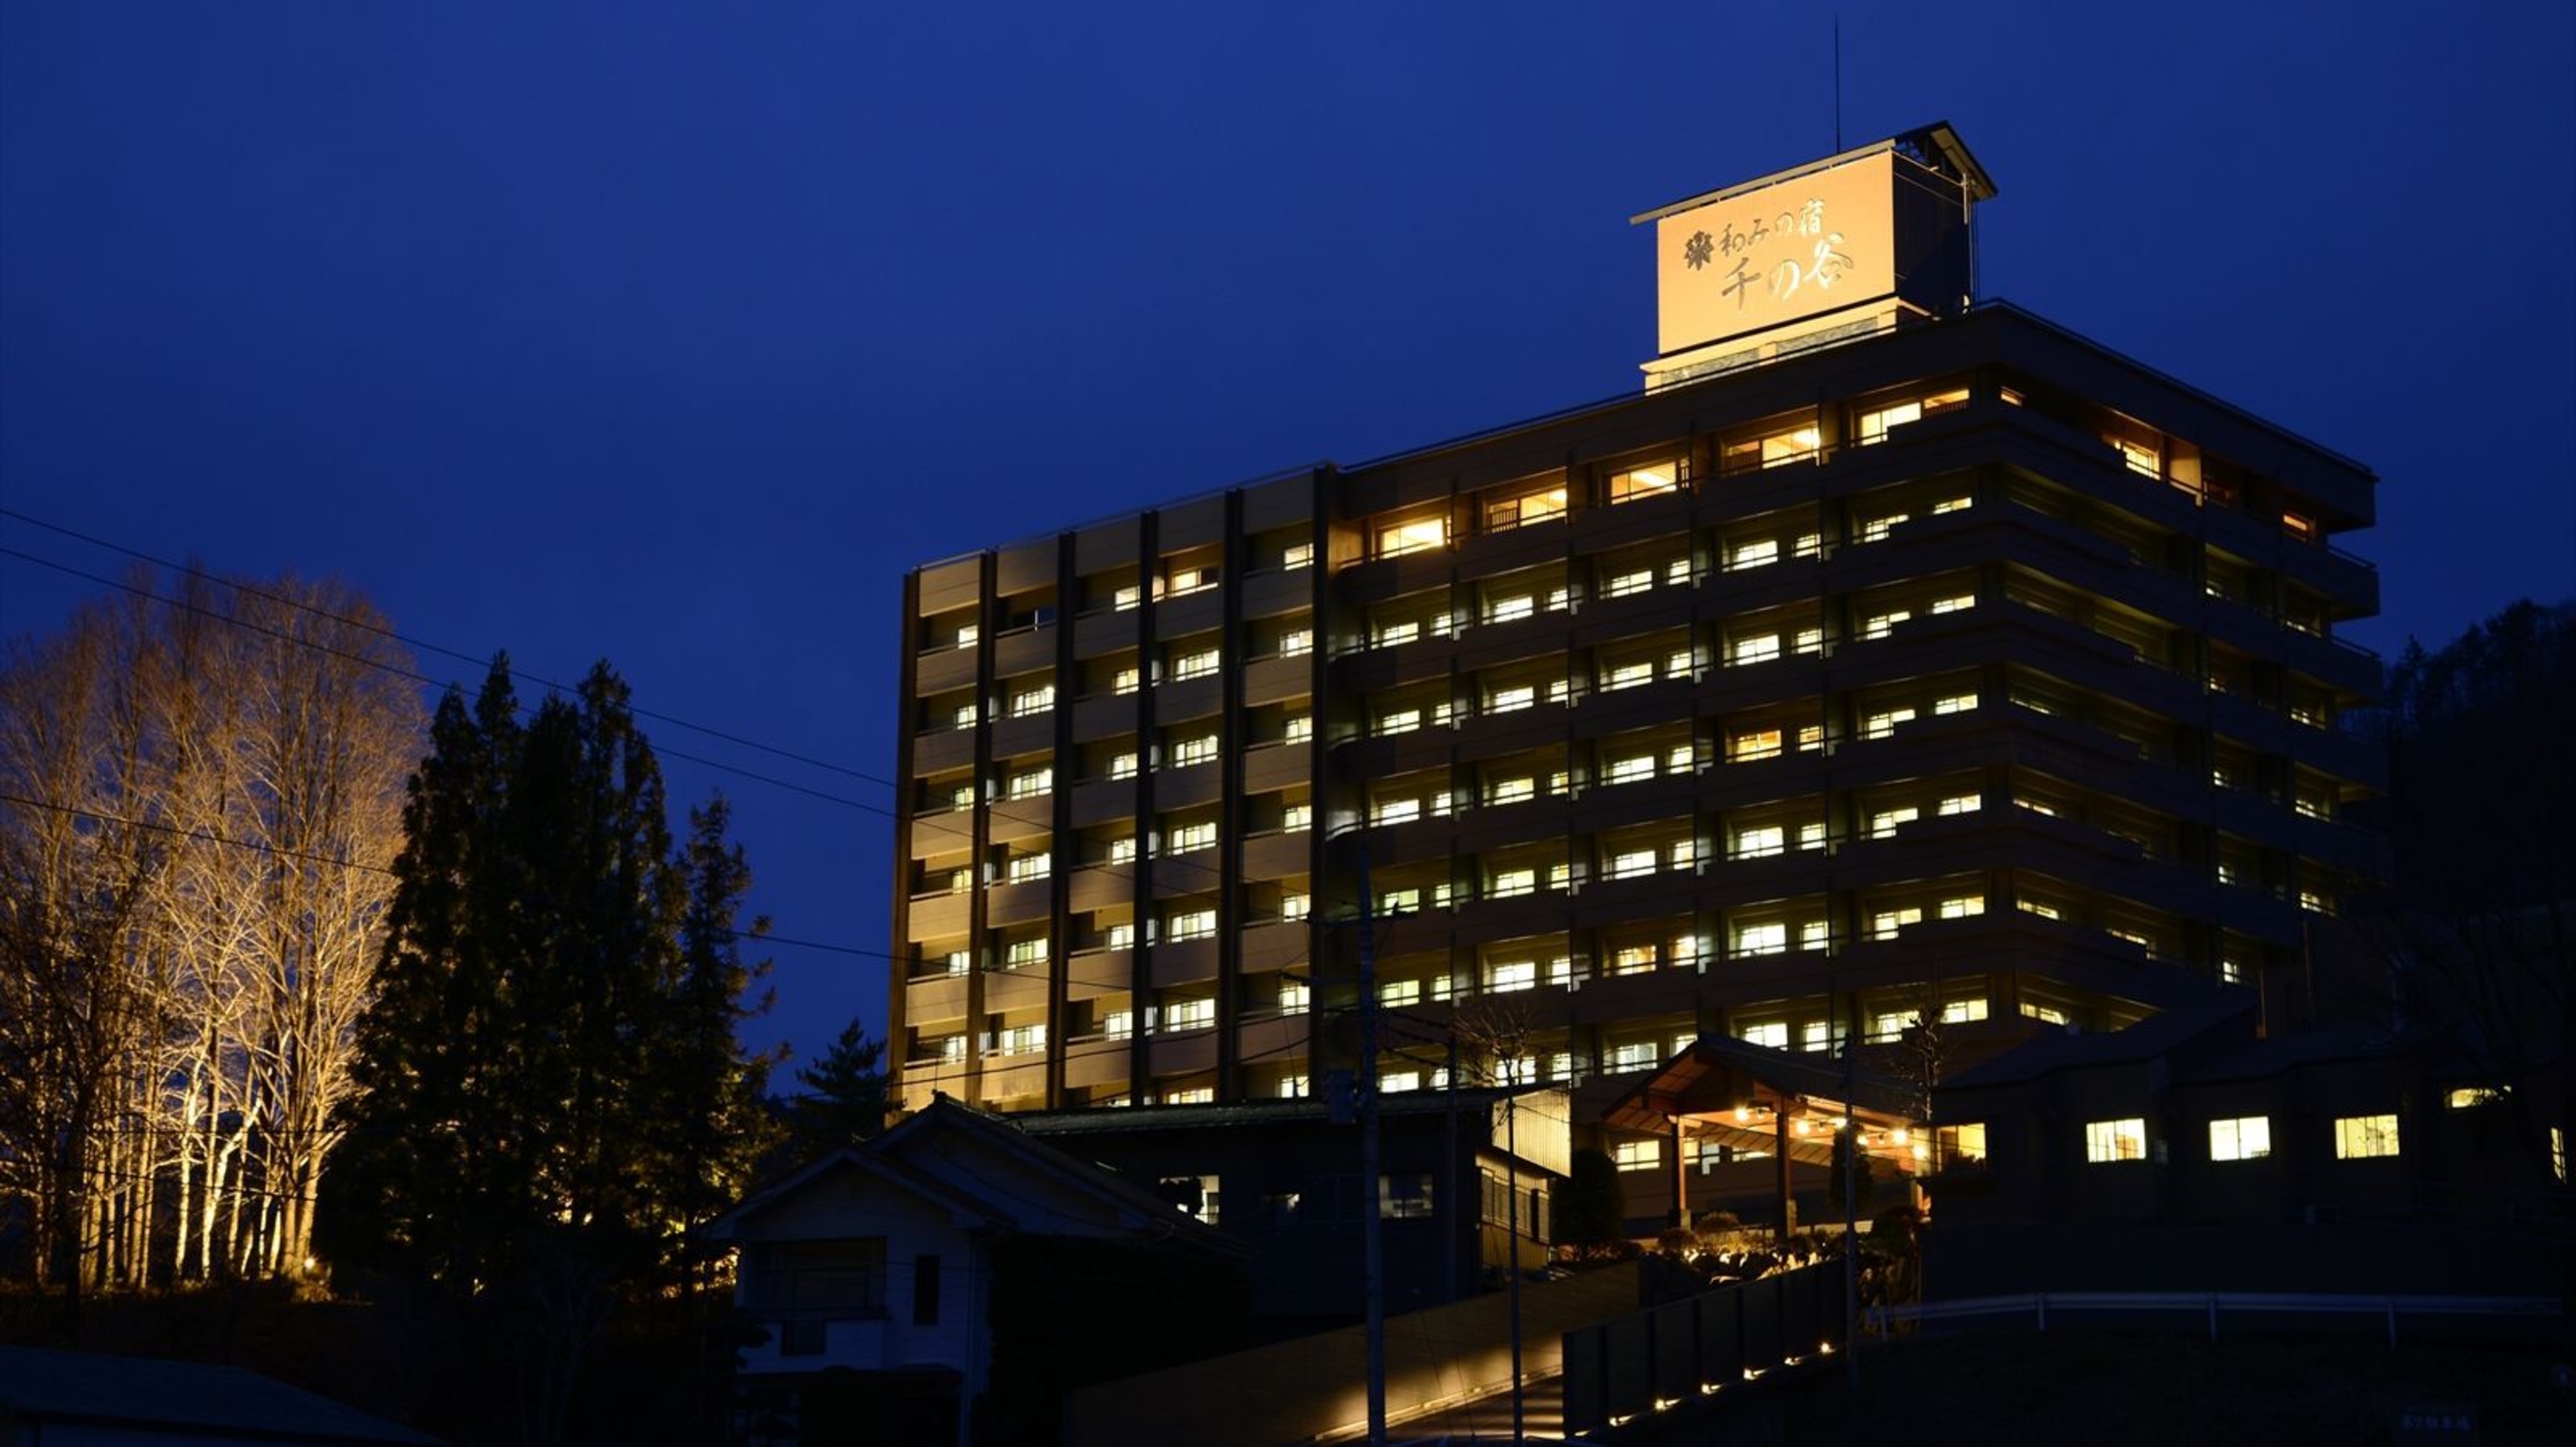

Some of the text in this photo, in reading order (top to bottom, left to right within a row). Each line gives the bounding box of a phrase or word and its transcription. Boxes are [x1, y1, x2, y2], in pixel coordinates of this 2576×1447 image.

[1719, 197, 1826, 258] 和みの宿
[1721, 231, 1855, 311] 千の谷
